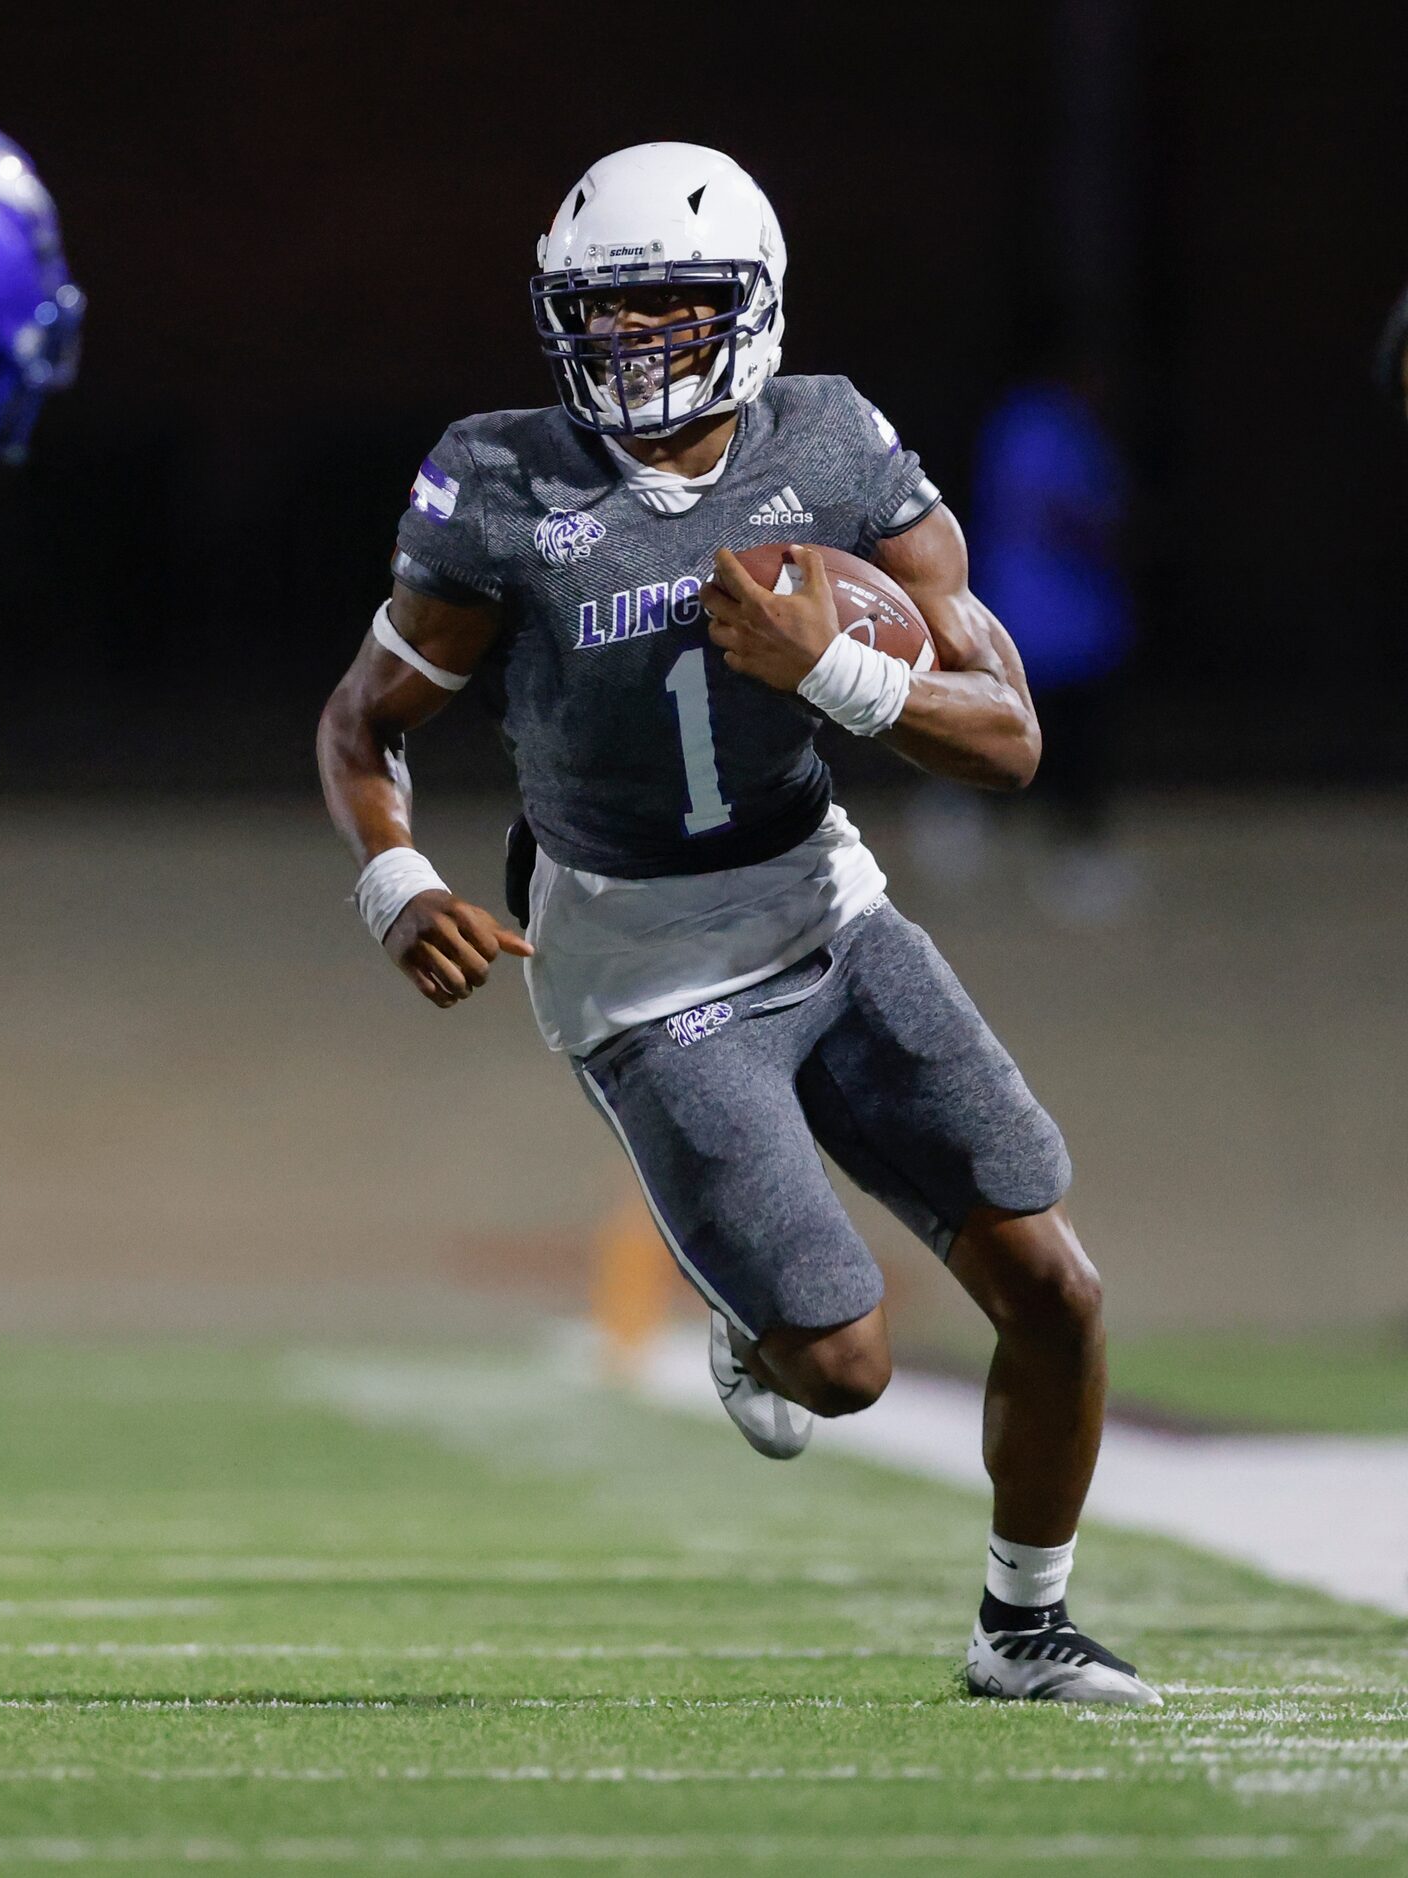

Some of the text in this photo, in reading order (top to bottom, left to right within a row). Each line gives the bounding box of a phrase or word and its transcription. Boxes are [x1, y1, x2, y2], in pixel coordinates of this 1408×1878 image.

[609, 246, 644, 257] schutt
[749, 509, 814, 526] adidas
[573, 575, 715, 650] LINC
[836, 579, 909, 631] TEAM ISSUE
[663, 645, 735, 839] 1
